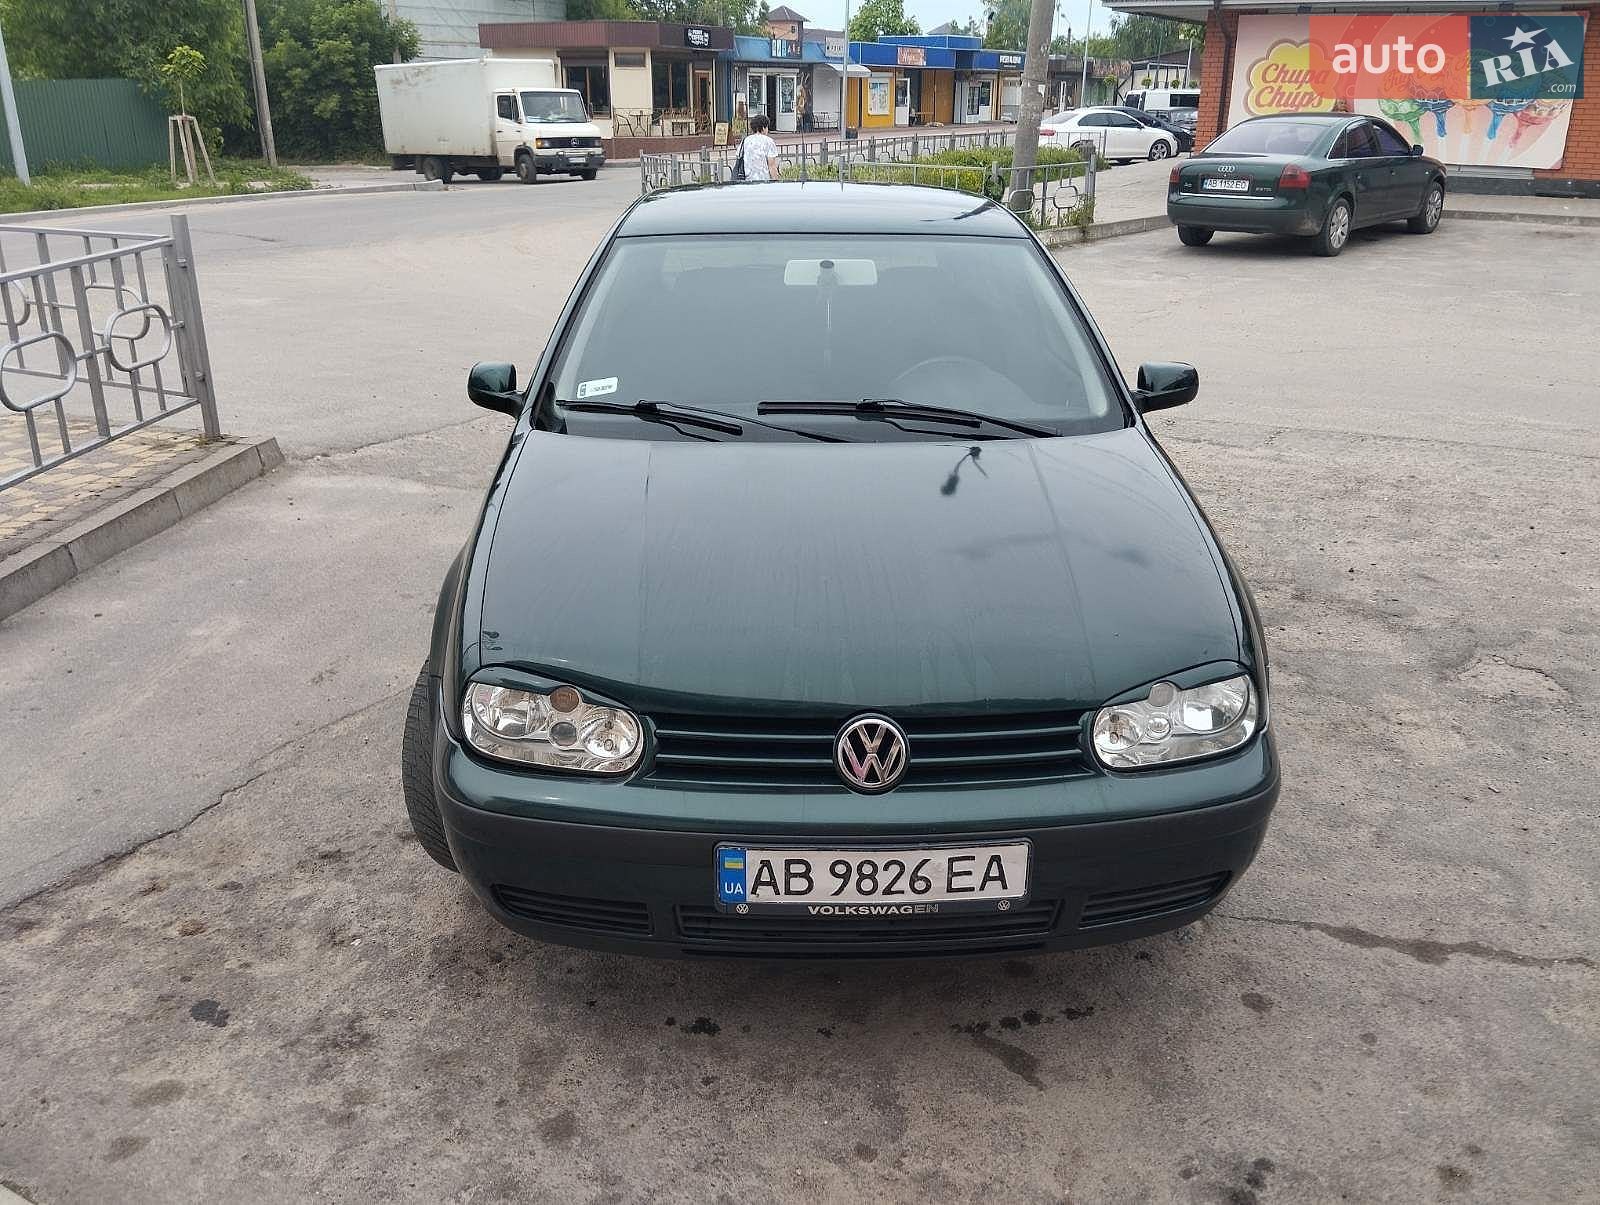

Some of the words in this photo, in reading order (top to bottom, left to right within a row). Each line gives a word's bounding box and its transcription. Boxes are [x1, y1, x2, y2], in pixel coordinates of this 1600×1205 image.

[1261, 63, 1330, 90] Chupa
[1254, 85, 1323, 111] Chups
[724, 882, 743, 895] UA
[750, 858, 815, 897] AB
[828, 858, 932, 897] 9826
[946, 854, 1008, 893] EA
[807, 903, 939, 915] VOLKSWAGEN
